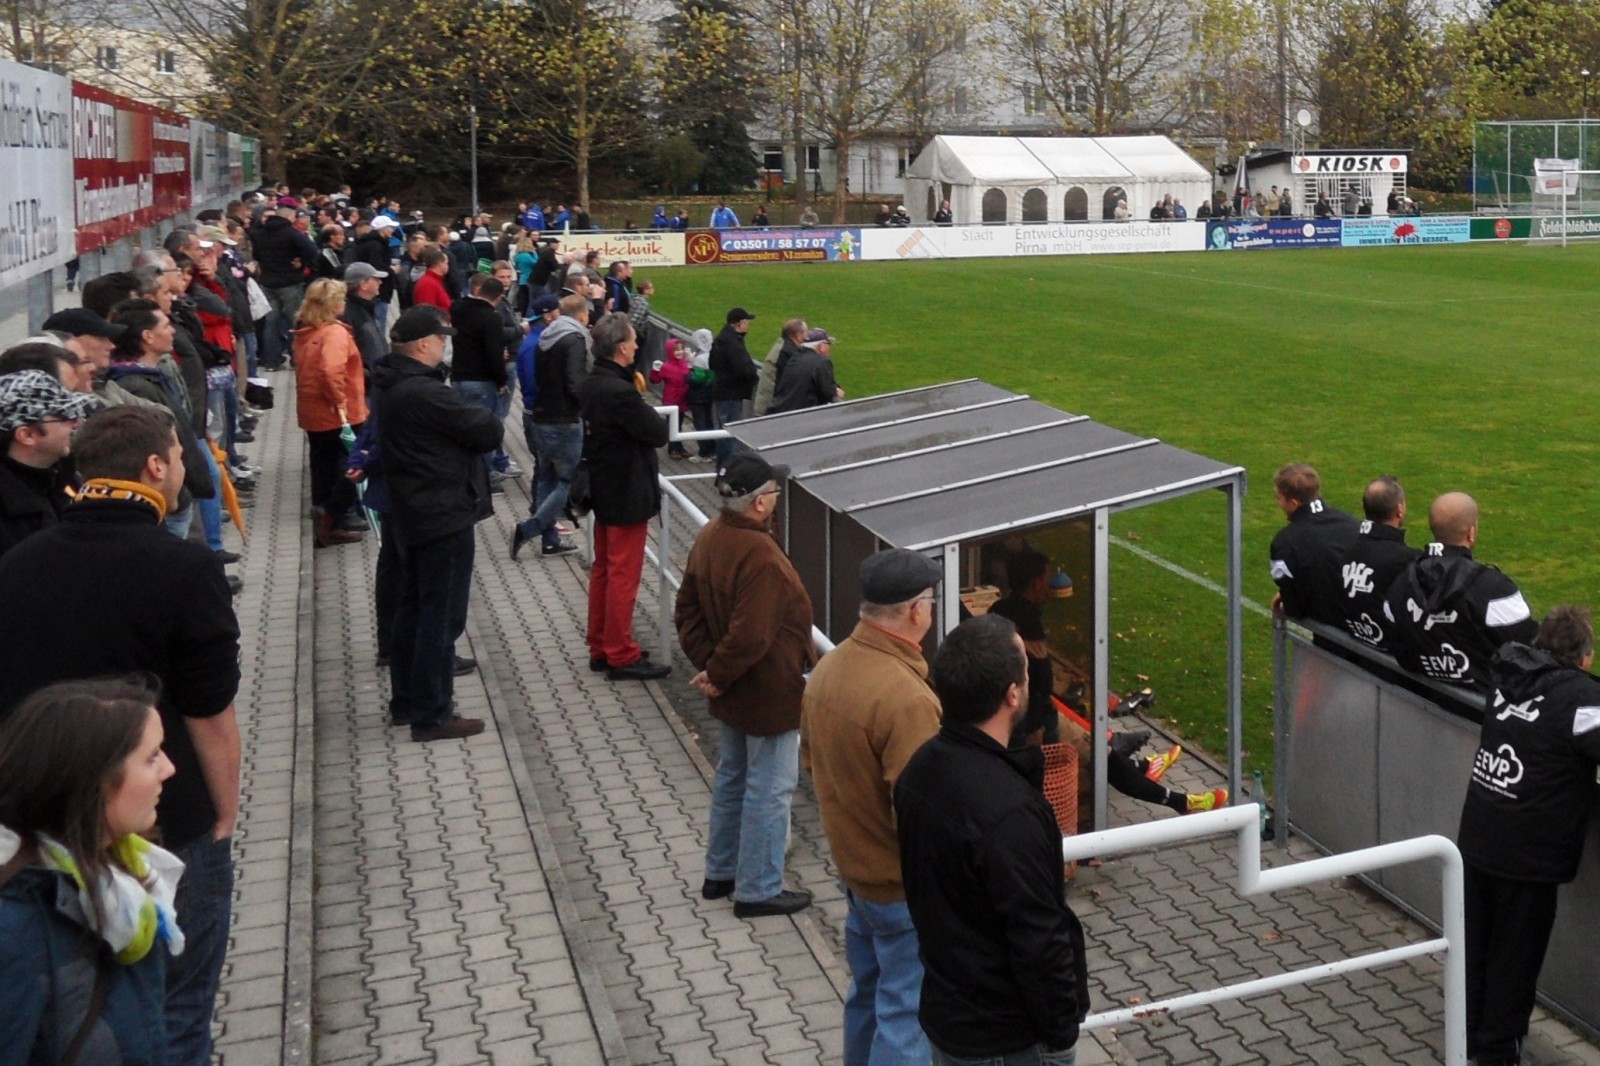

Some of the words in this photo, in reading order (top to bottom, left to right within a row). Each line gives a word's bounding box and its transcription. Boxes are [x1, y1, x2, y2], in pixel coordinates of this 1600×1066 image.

[1317, 157, 1384, 172] KIOSK
[961, 229, 994, 242] Stadt
[1015, 225, 1171, 243] Entwicklungsgesellschaft
[1540, 218, 1600, 238] Feldshlößche
[733, 240, 768, 249] 03501
[778, 239, 793, 249] 58
[796, 239, 809, 248] 57
[812, 238, 826, 248] 07
[1015, 242, 1048, 253] Pirna
[1053, 240, 1082, 252] mbH
[1309, 499, 1324, 514] 13
[1428, 542, 1445, 557] TR
[1429, 655, 1457, 672] EVP
[1481, 750, 1511, 777] EVP
